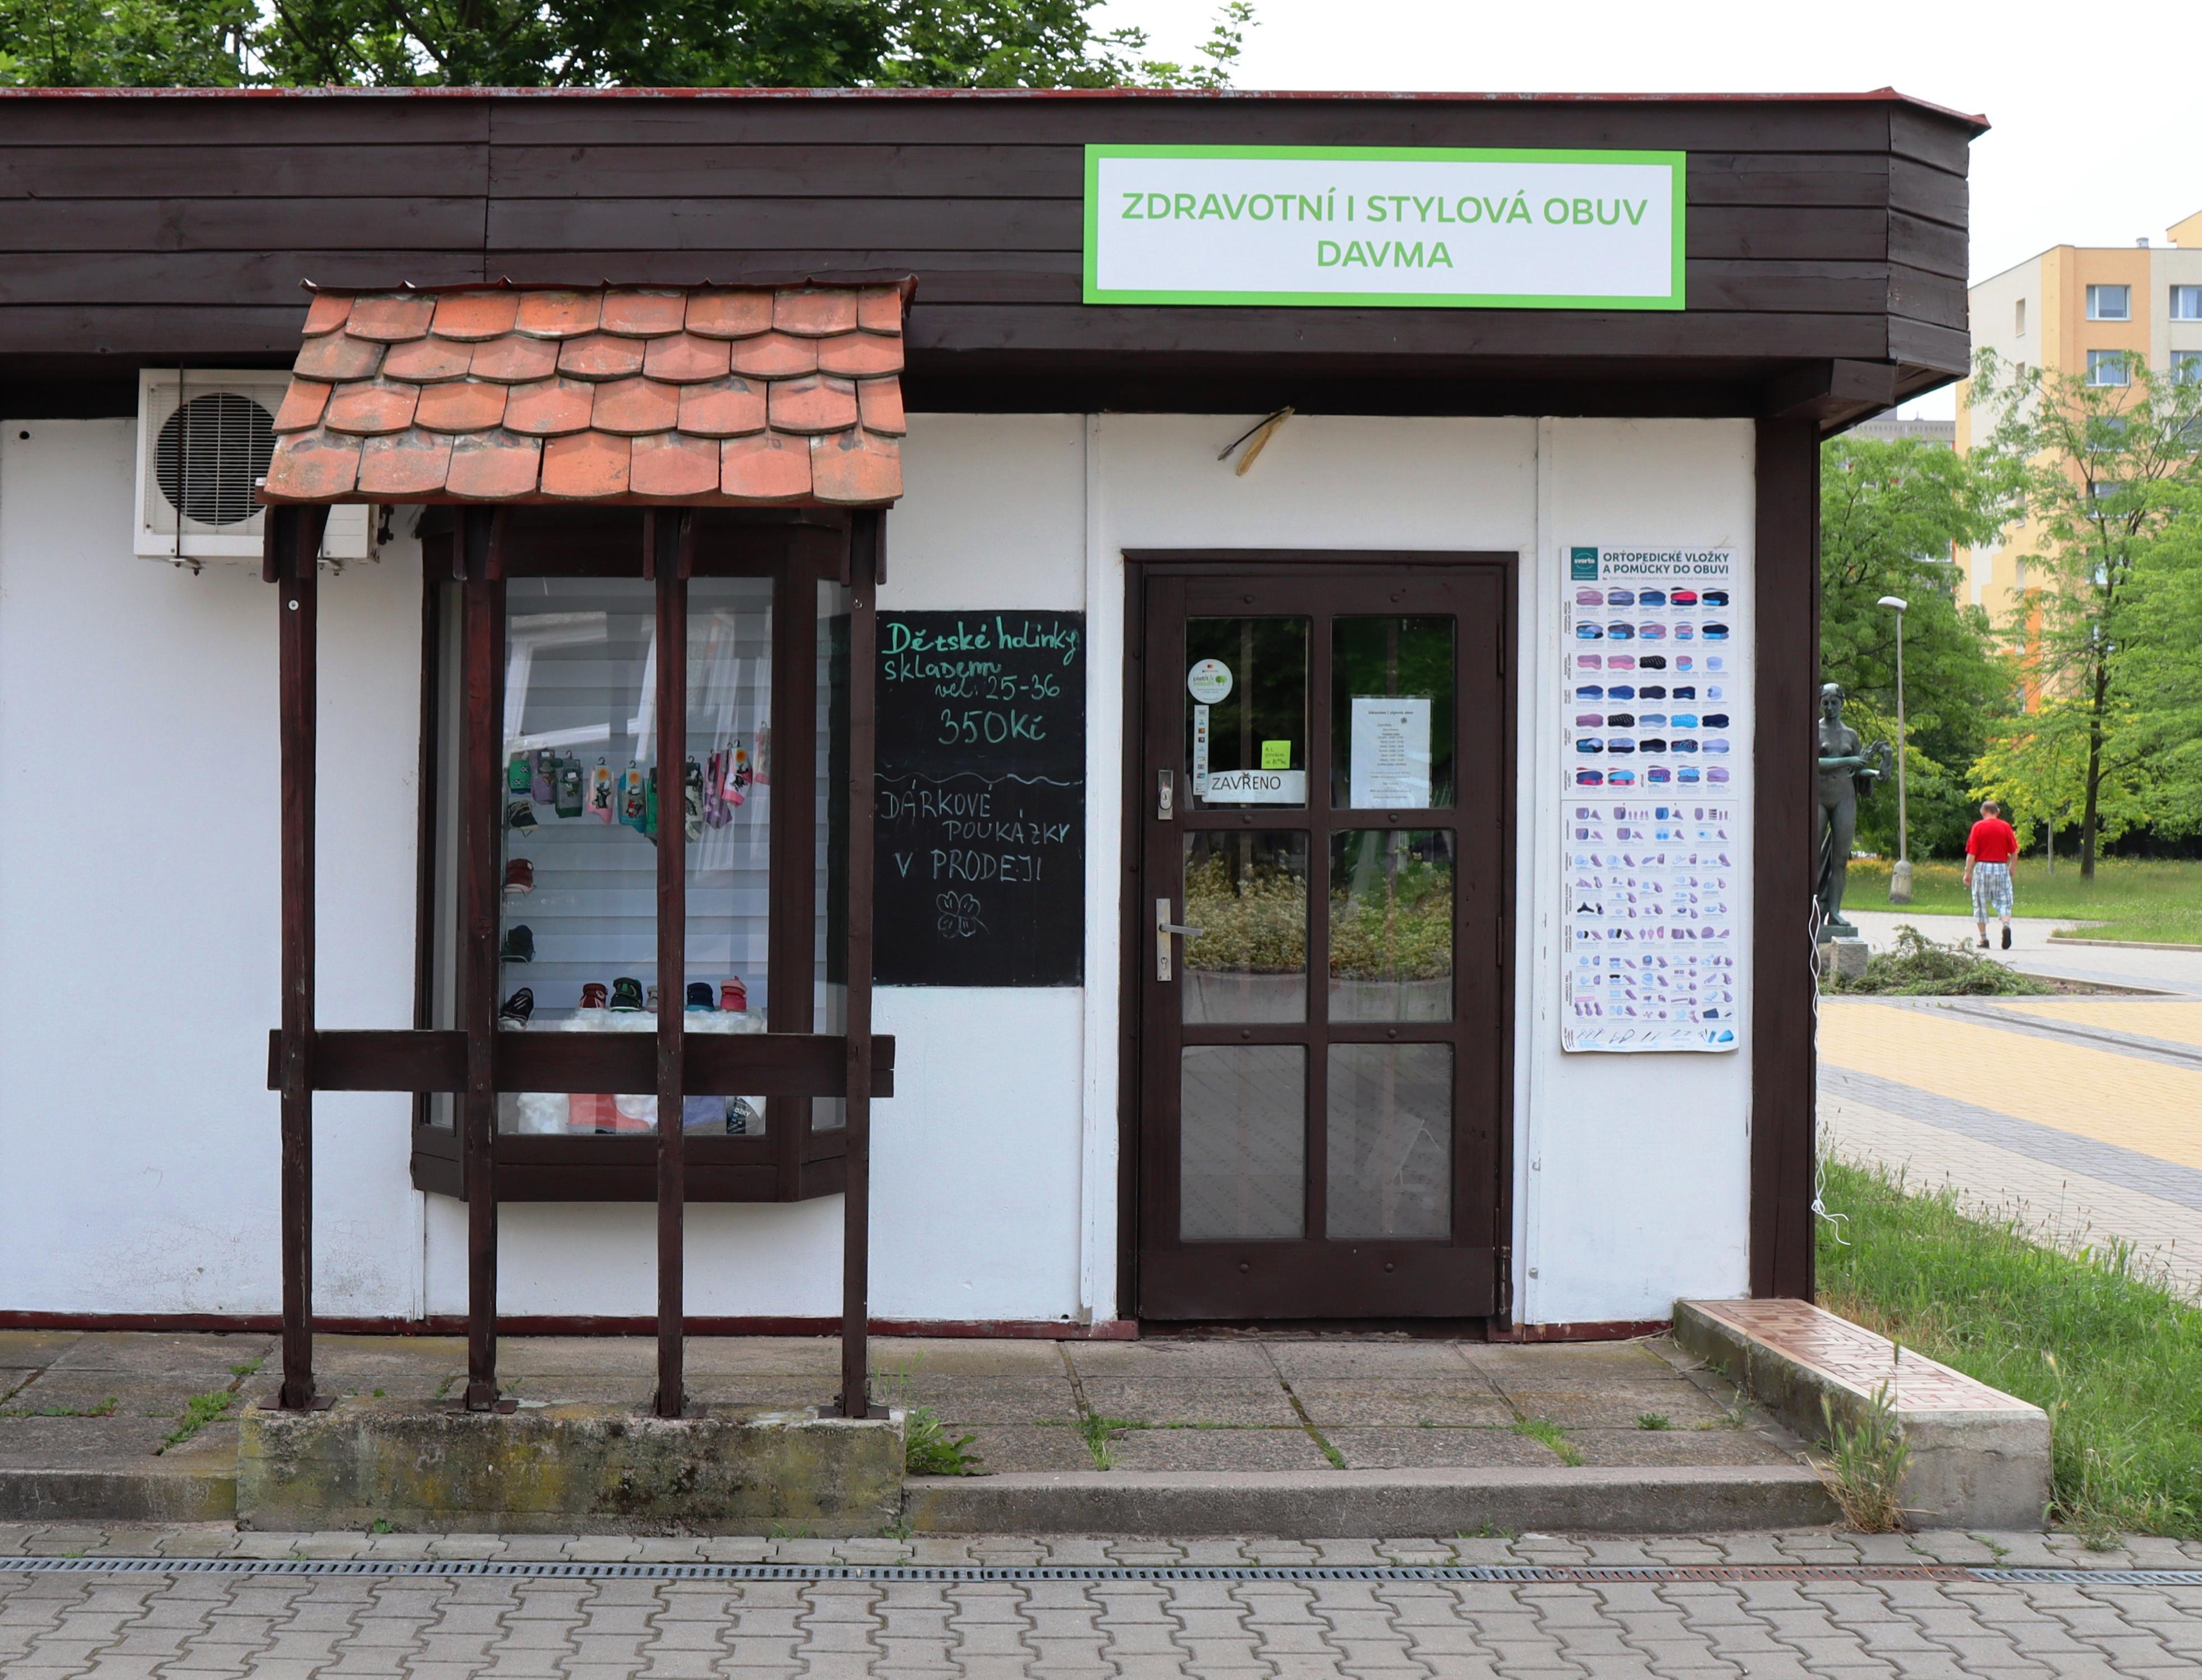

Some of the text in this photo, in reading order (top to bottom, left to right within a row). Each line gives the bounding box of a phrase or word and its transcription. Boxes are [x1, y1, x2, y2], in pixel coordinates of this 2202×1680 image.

[1121, 187, 1647, 225] ZDRAVOTNÍ I STYLOVÁ OBUV
[1317, 240, 1453, 268] DAVMA
[1603, 550, 1729, 563] ORTOPEDICKÉ VLOŽKY
[1603, 562, 1729, 574] A POMŮCKY DO OBUVI
[881, 616, 1078, 666] Dětské holinky
[985, 674, 1060, 701] 25-36
[1212, 772, 1281, 790] ZAVŘENO
[881, 779, 993, 819] DÁRKOVÉ
[942, 808, 1070, 844] POUKÁZKY
[896, 848, 1042, 882] V PRODEJI
